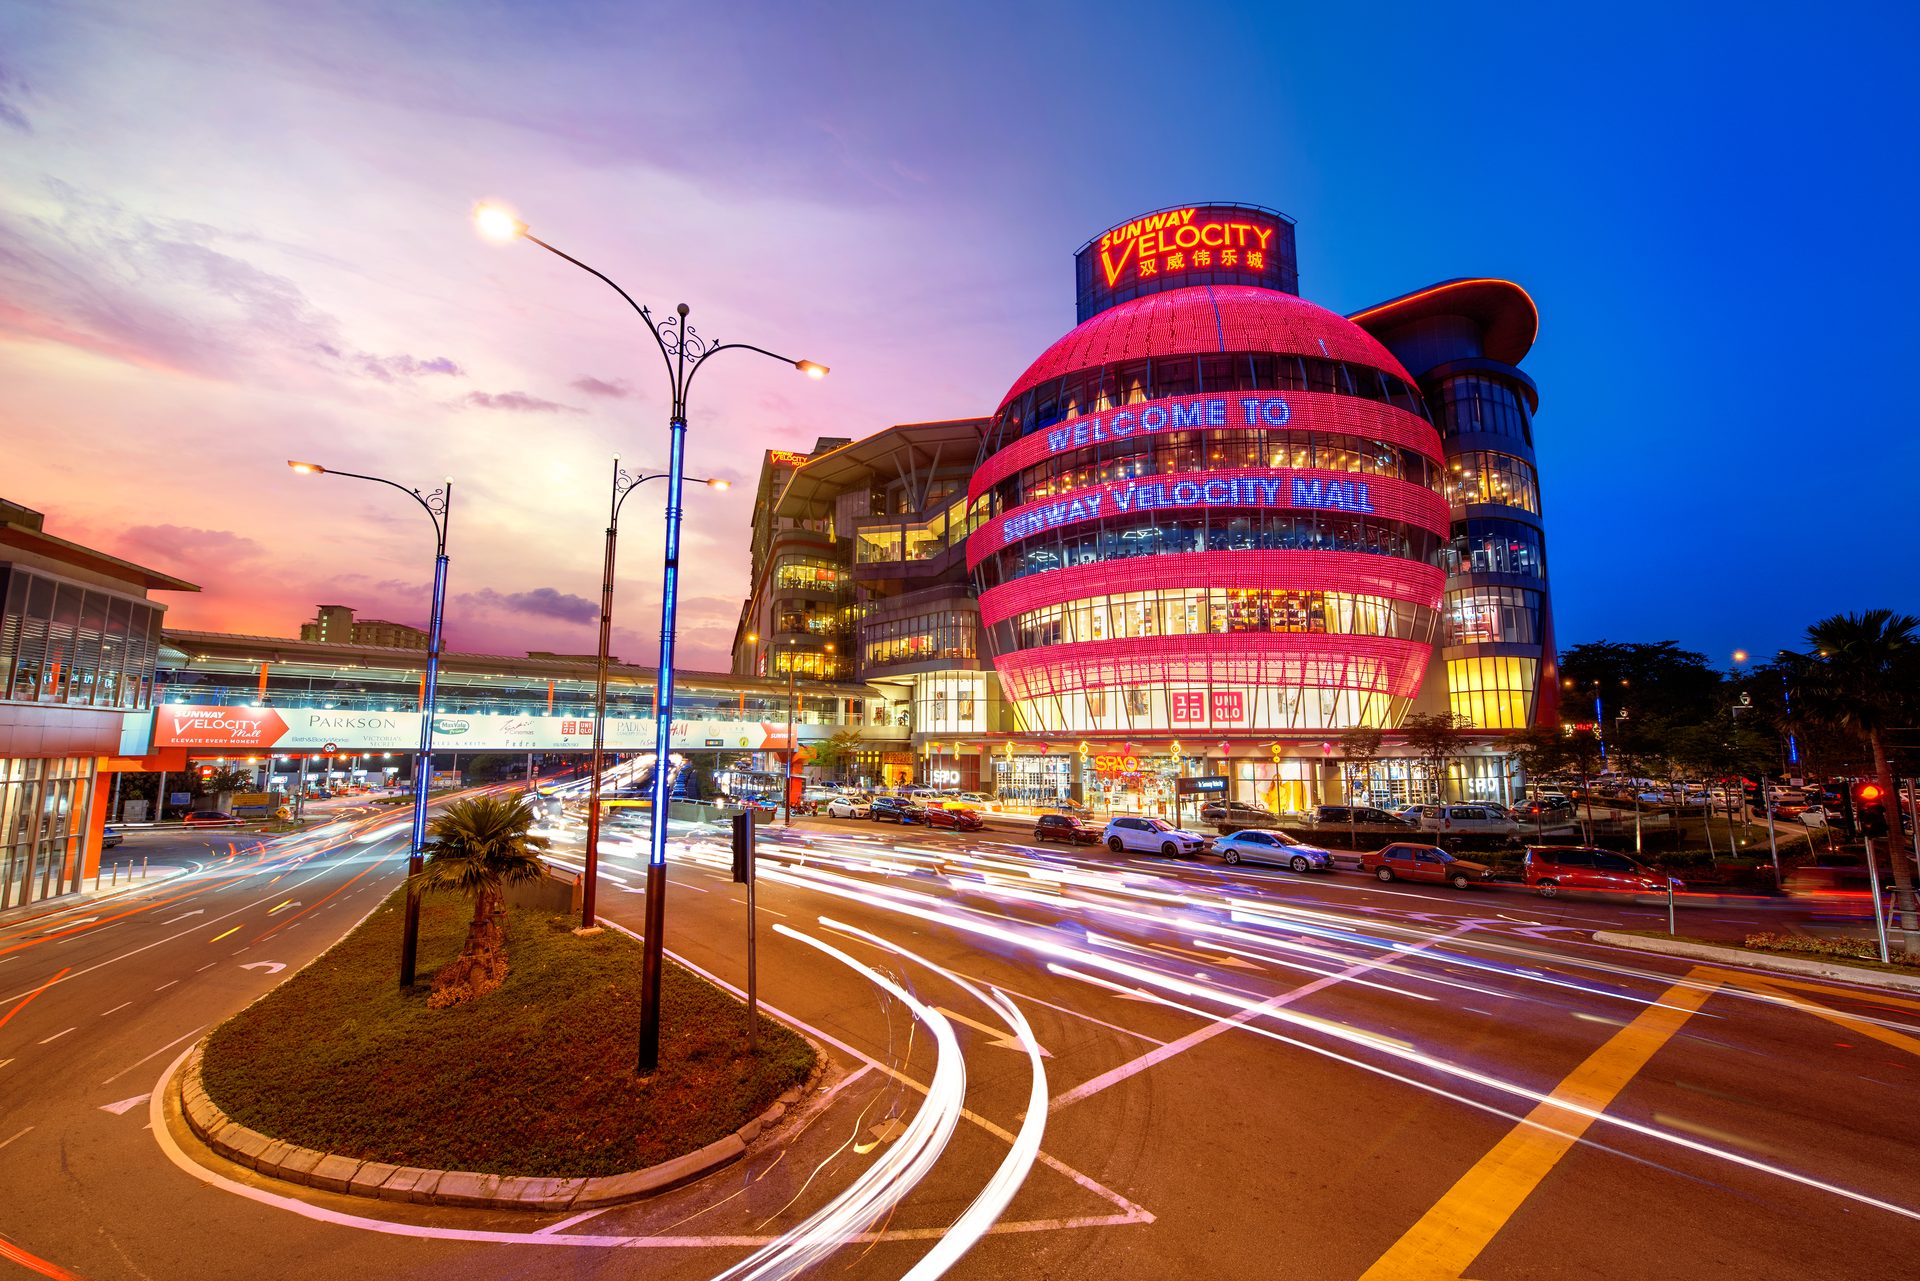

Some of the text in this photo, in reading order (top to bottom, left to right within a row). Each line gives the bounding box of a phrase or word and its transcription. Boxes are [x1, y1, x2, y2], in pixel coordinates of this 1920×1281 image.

[1101, 208, 1195, 252] SUNWAY
[1101, 222, 1272, 287] VELOCITY
[1139, 249, 1264, 277] 双威伟乐城
[1047, 397, 1292, 452] WELCOME TO
[771, 453, 807, 463] VELOCITY
[1003, 477, 1374, 543] SUNWAY VELOCITY MALL
[1214, 695, 1238, 706] UNI
[174, 710, 225, 718] SUNWAY
[309, 715, 397, 729] PARKSON
[1215, 708, 1240, 720] QLO
[173, 719, 262, 736] VELOCITY
[231, 729, 262, 738] Mall
[1095, 755, 1138, 772] SPAO
